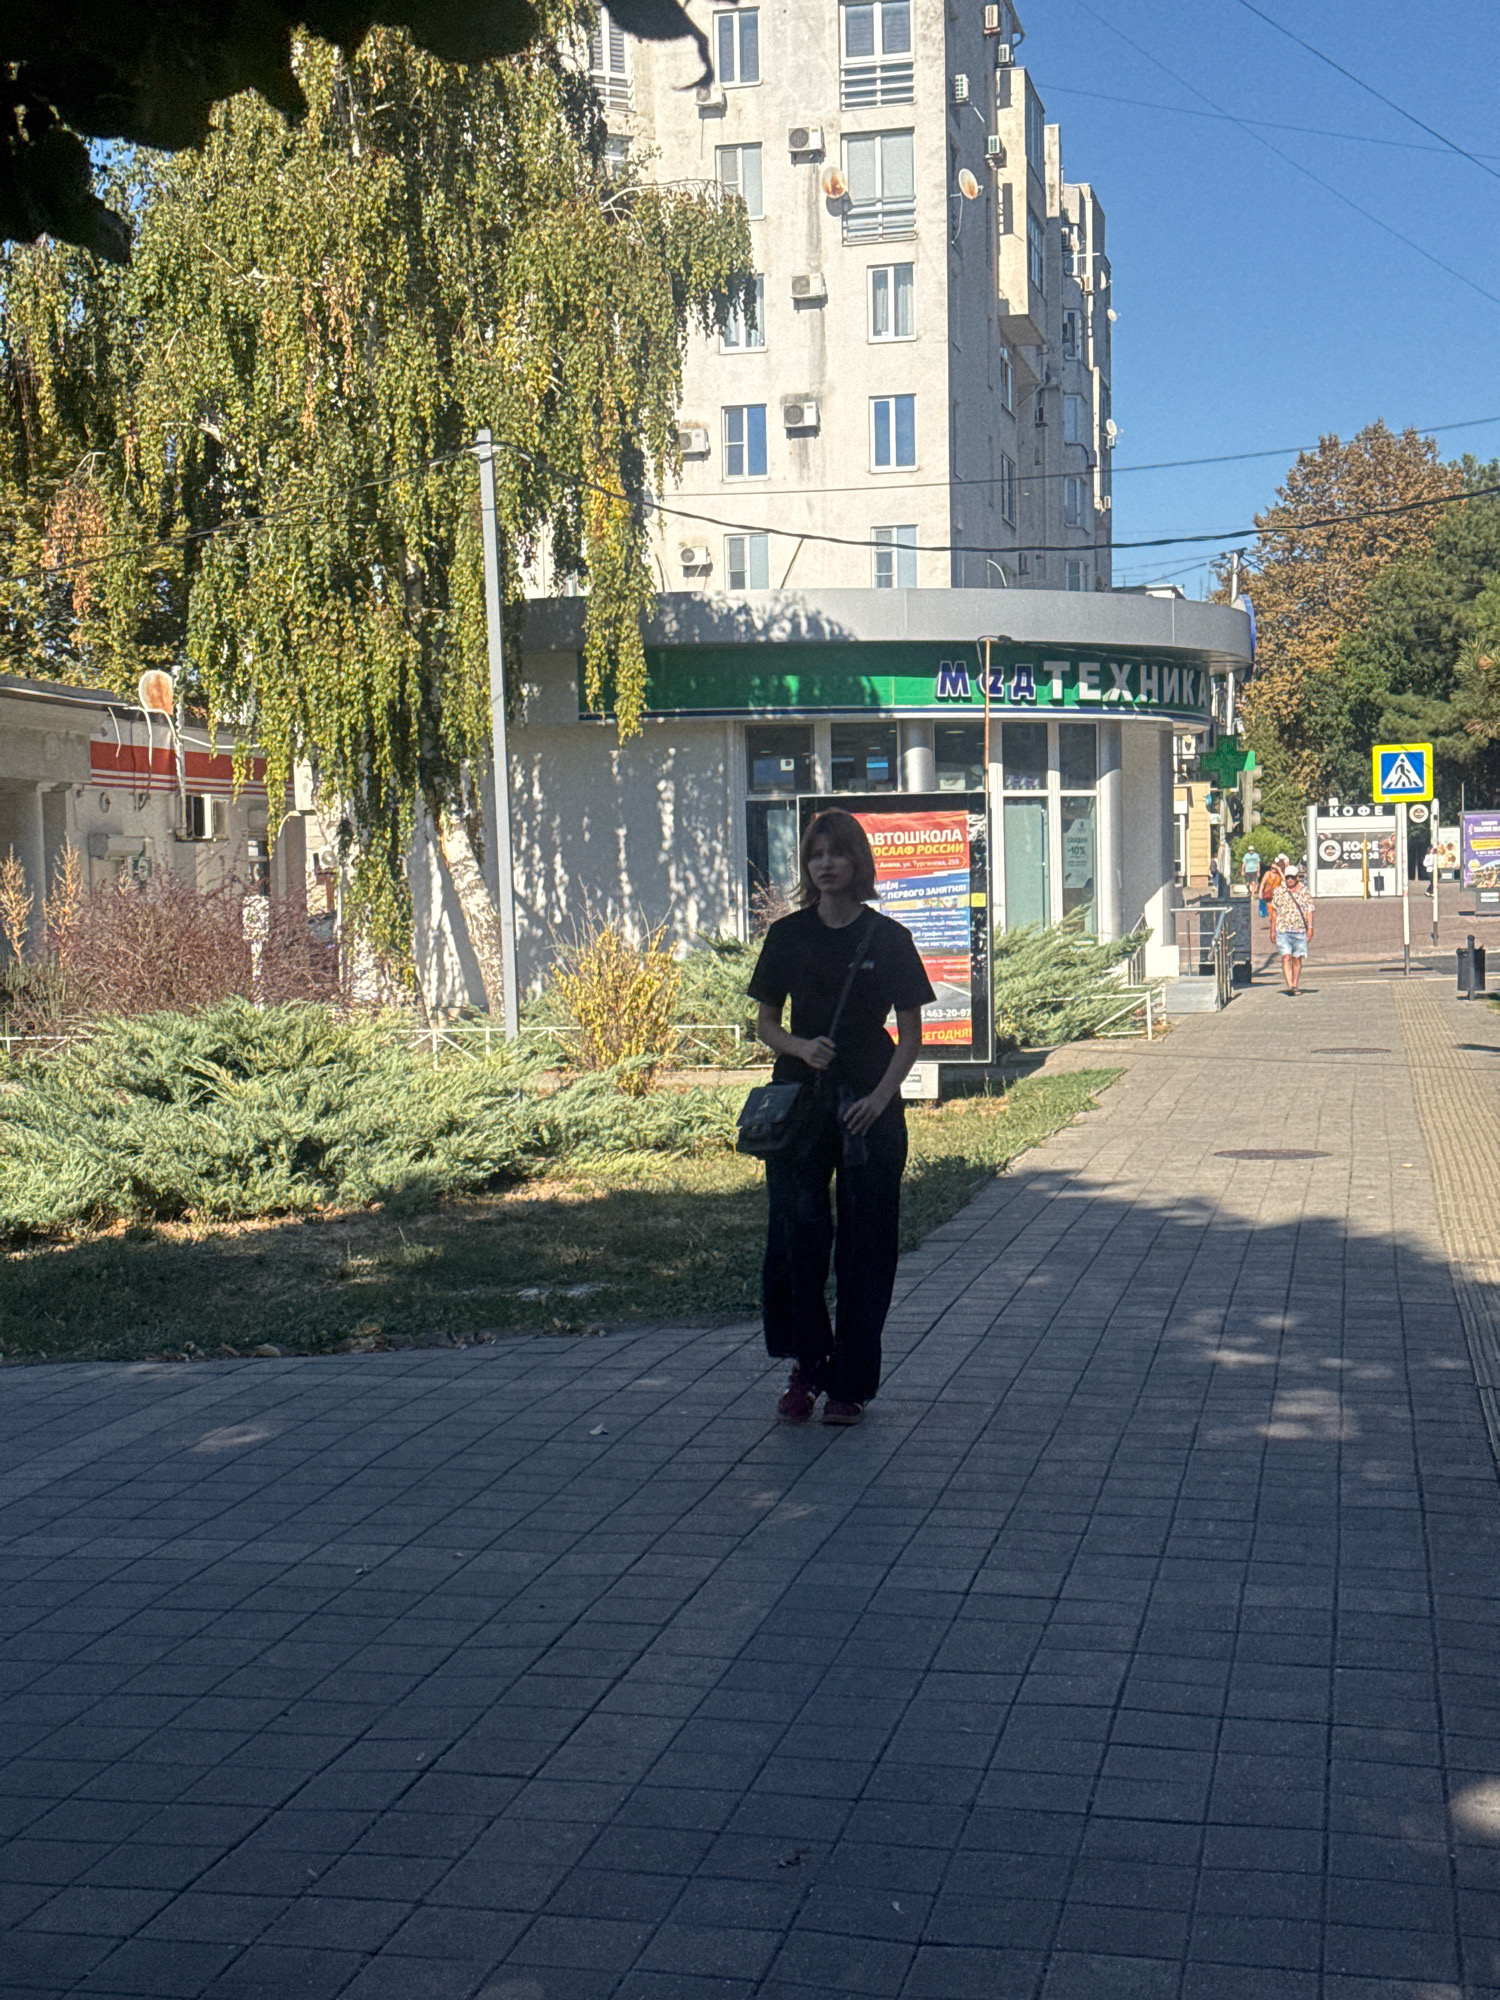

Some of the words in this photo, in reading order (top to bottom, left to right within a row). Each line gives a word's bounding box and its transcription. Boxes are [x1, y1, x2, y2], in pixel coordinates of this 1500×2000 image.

[1329, 805, 1383, 816] КОФЕ
[873, 845, 915, 857] ОСААФ
[917, 842, 964, 855] РОССИИ
[1350, 851, 1379, 860] СООЙ
[874, 881, 899, 891] УЛЁМ
[887, 888, 924, 900] ПЕРВОГО
[925, 884, 967, 896] ЗАНЯТИЯ!
[926, 1008, 971, 1018] 463-20-97
